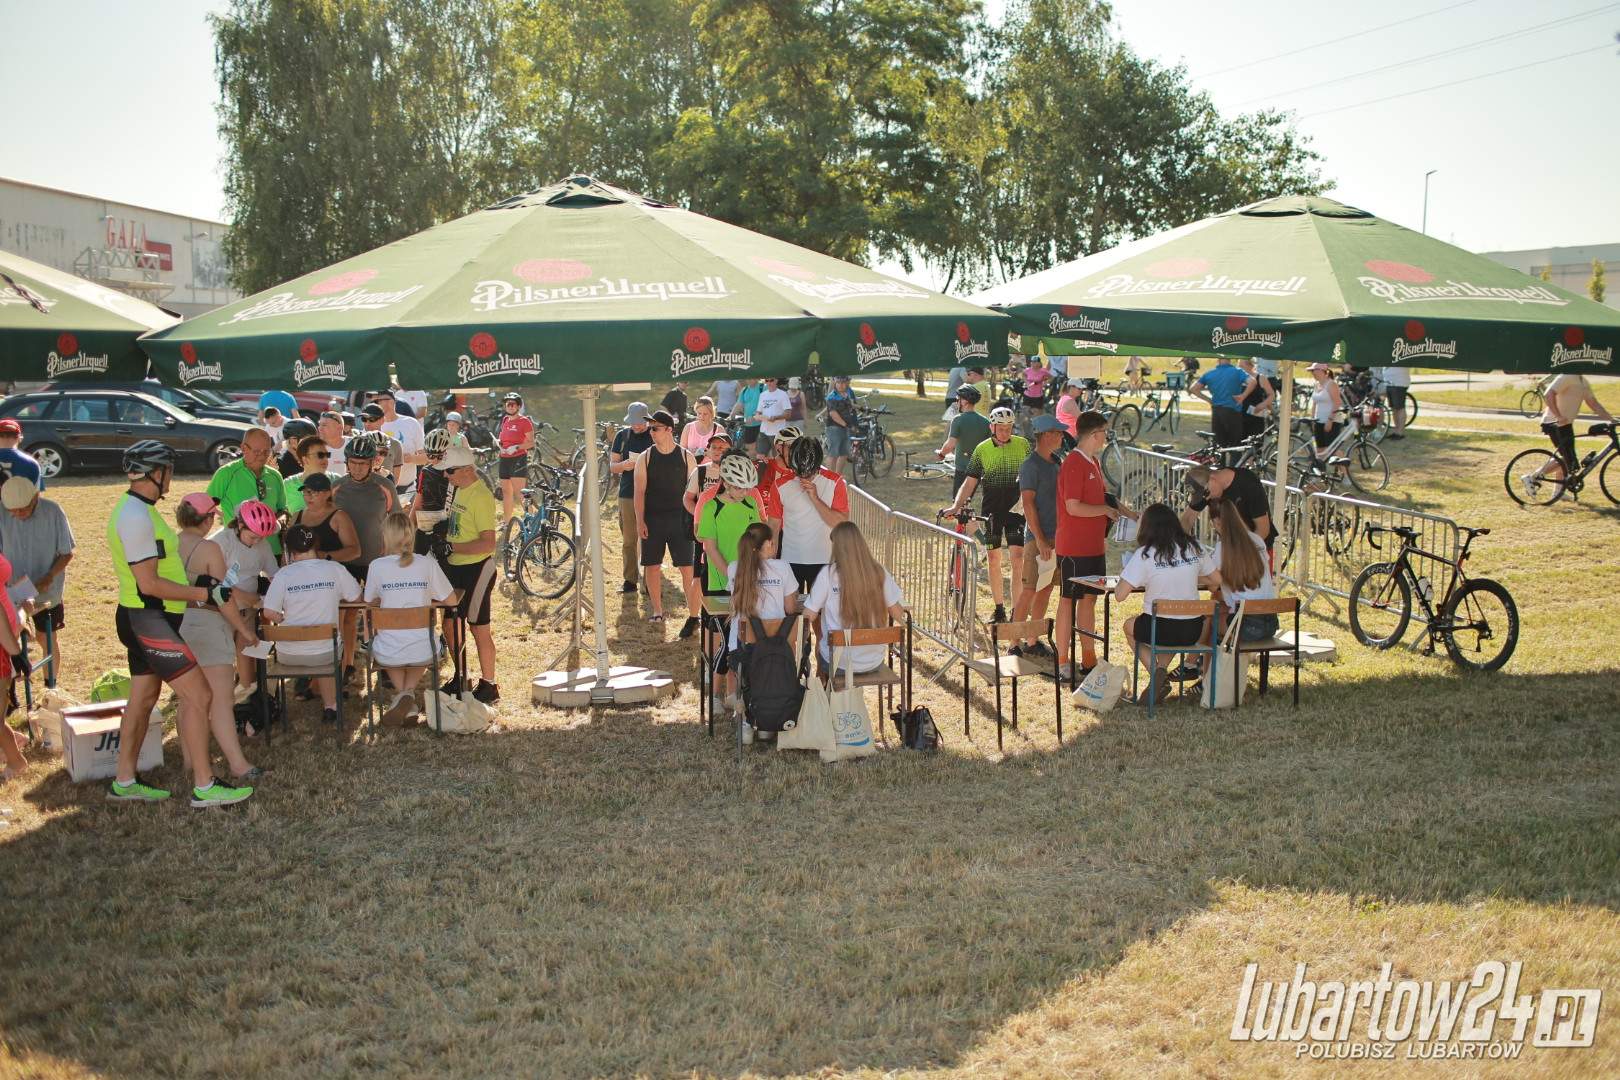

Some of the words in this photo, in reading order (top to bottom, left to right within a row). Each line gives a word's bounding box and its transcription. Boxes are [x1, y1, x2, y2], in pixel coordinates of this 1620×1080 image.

[470, 279, 605, 311] Pilsner
[600, 276, 728, 300] Urquell
[1082, 274, 1203, 299] Pilsner
[1199, 274, 1308, 296] Urquell
[1357, 276, 1460, 304] Pilsner
[1447, 280, 1562, 304] Urquell
[1049, 313, 1080, 334] Pilsner
[1079, 314, 1110, 334] Urquell
[1212, 327, 1248, 349] Pilsner
[1246, 328, 1281, 347] Urquell
[1392, 338, 1426, 363] Pilsner
[1425, 337, 1456, 359] Urquell
[47, 351, 80, 378] Pilsner
[78, 350, 108, 373] Urquell
[458, 355, 500, 384] Pilsner
[499, 352, 541, 376] Urquell
[671, 349, 712, 378] Pilsner
[711, 347, 751, 370] Urquell
[1551, 343, 1583, 367] Pilsner
[1583, 343, 1612, 365] Urquell
[294, 360, 319, 387] Pilsner
[317, 358, 346, 381] Urquell
[287, 581, 336, 592] WOLONTARIUSZ
[95, 731, 121, 751] JH
